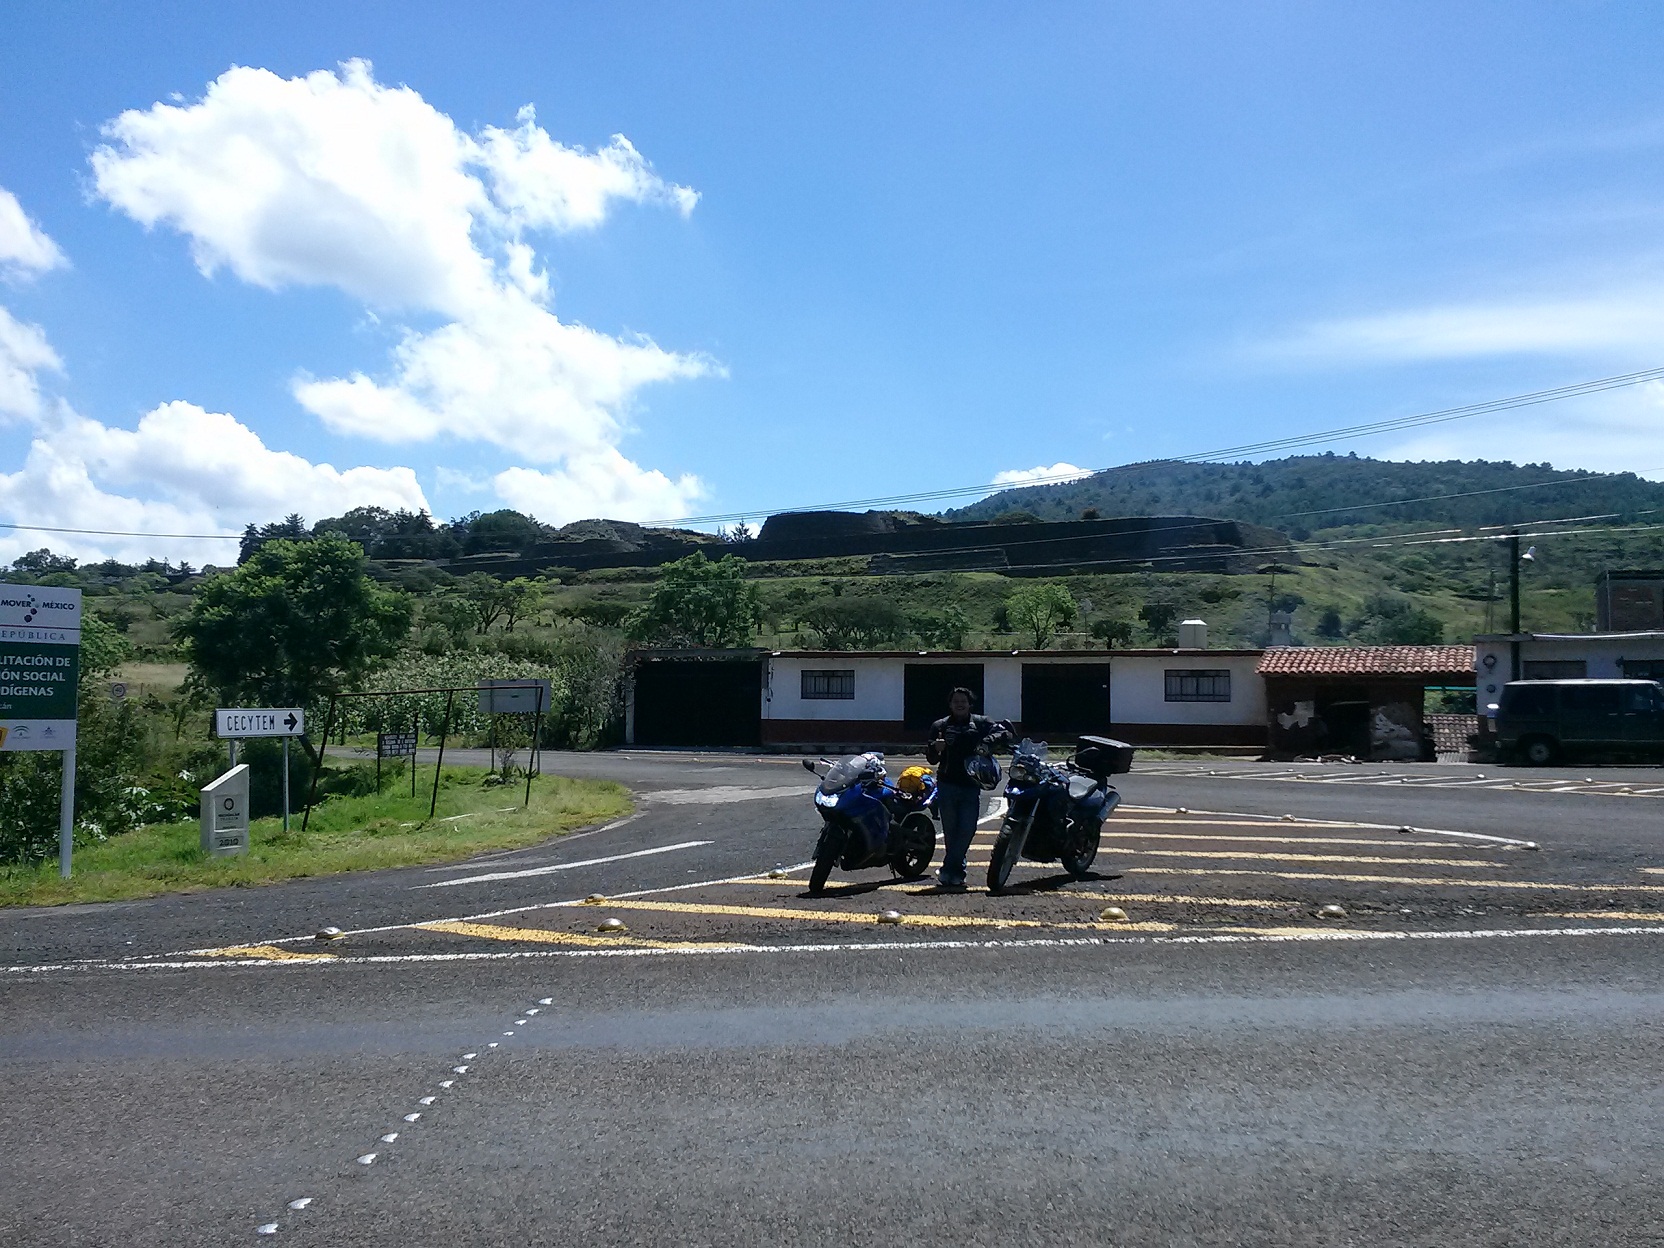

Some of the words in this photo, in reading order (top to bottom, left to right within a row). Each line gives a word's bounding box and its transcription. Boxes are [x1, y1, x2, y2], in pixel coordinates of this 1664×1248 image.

[1, 599, 32, 608] MOVER
[42, 601, 76, 610] MÉXICO
[55, 657, 71, 667] DE
[23, 671, 66, 682] SOCIAL
[0, 684, 54, 696] DÍGENAS
[227, 715, 275, 731] CECYTEM
